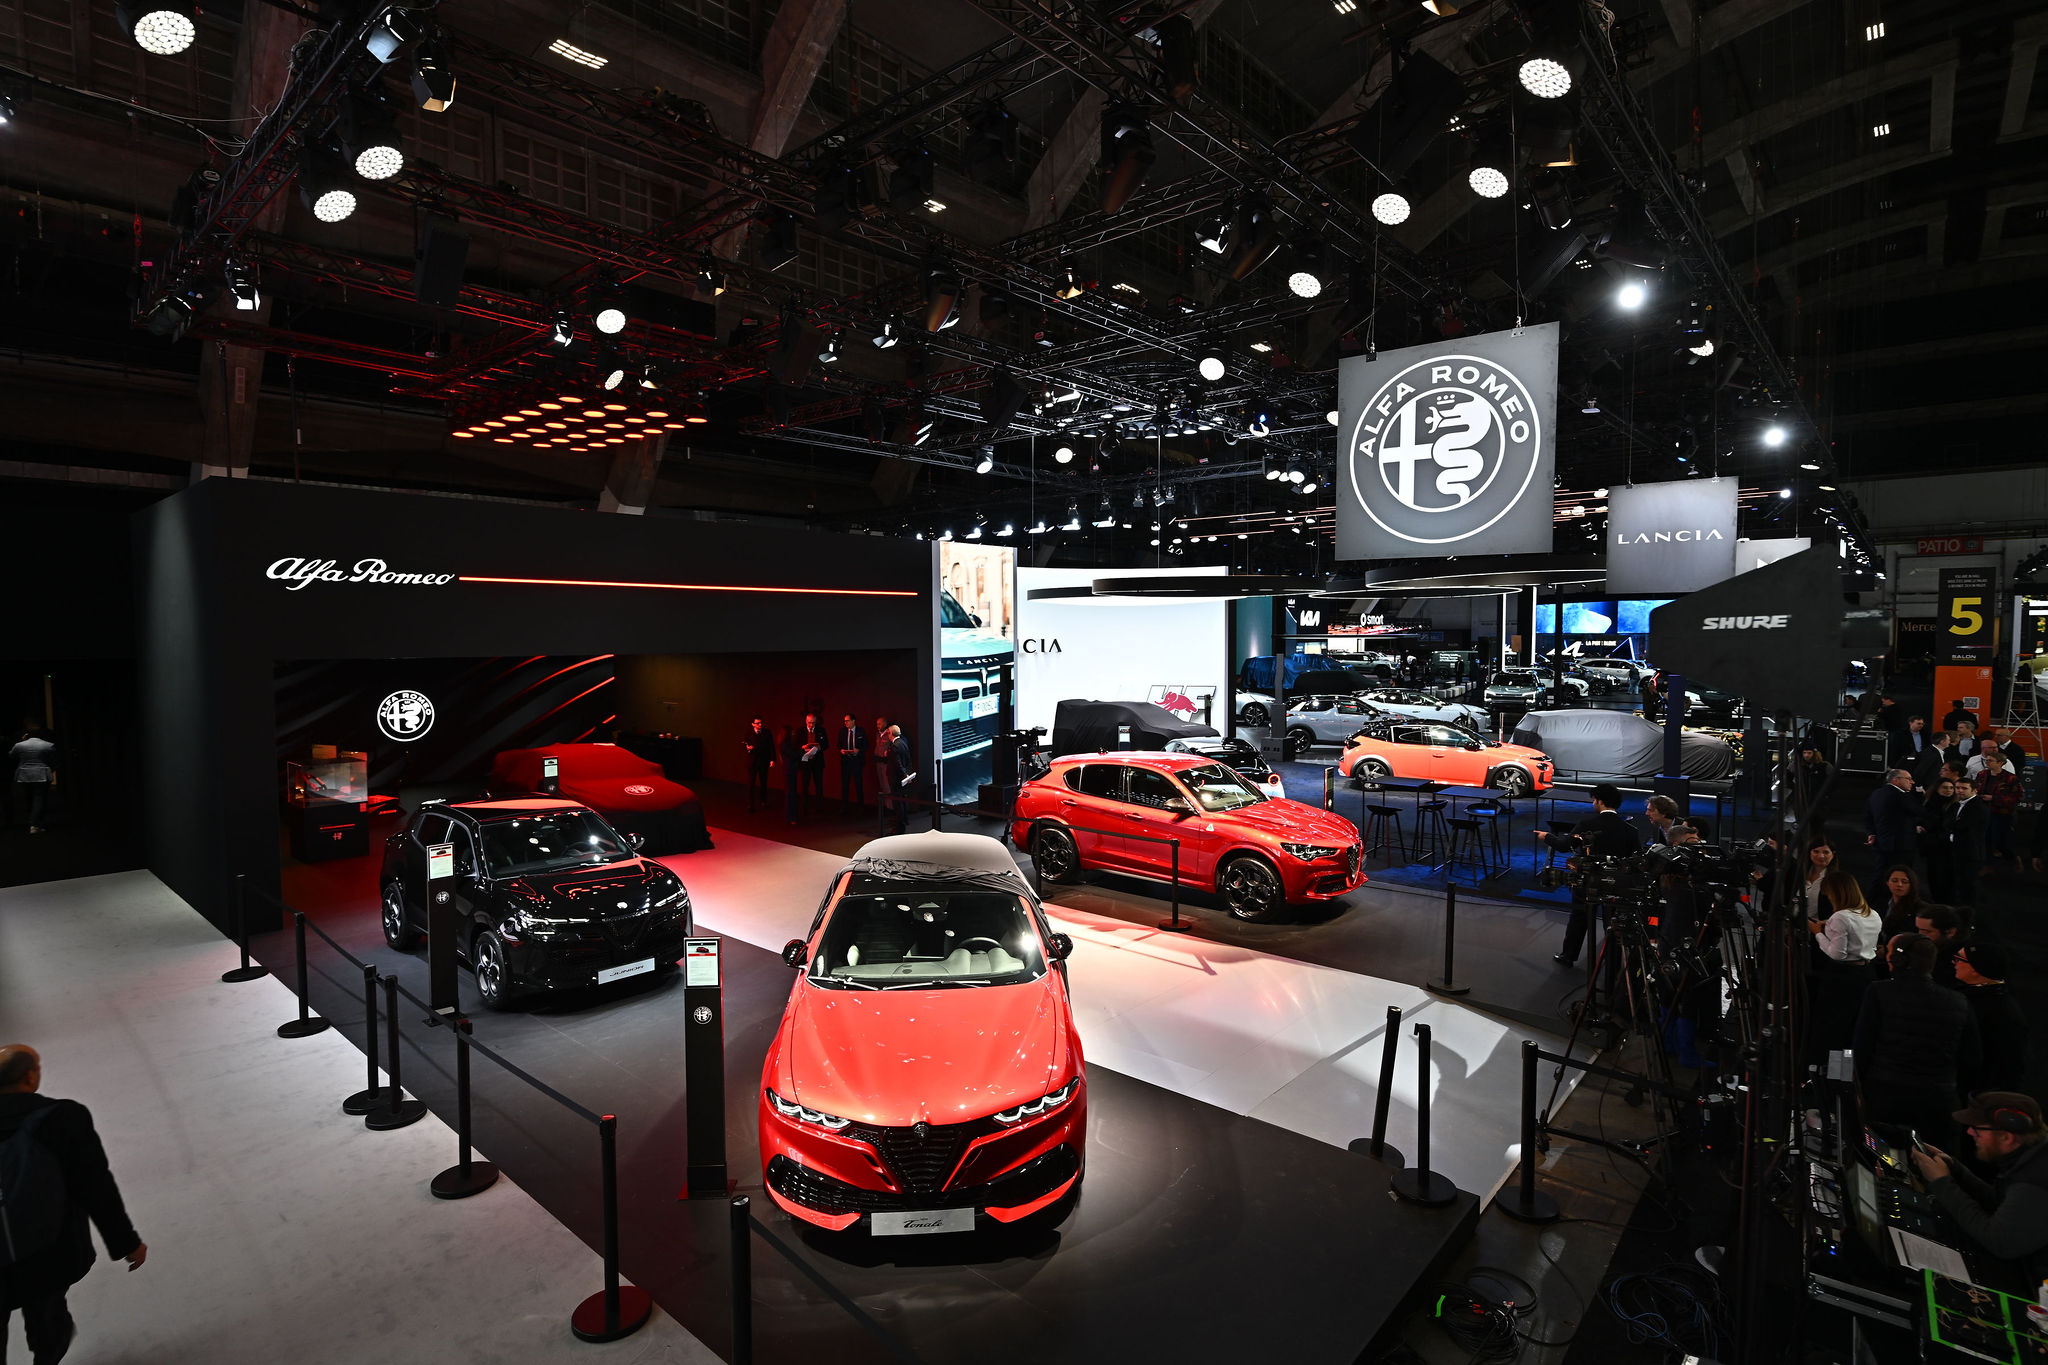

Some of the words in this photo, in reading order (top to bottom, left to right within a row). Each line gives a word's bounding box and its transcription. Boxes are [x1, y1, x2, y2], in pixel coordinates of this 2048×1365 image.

[1358, 381, 1417, 459] ALFA
[1430, 365, 1530, 445] ROMEO
[1618, 528, 1724, 545] LANCIA
[1917, 539, 1961, 553] PATIO
[265, 557, 348, 591] Alfa
[348, 558, 456, 586] Romeo
[1366, 614, 1384, 626] smart
[1702, 614, 1789, 630] SHURE
[1948, 597, 1983, 636] 5
[1017, 638, 1062, 654] CIA
[958, 657, 999, 665] LANCIA
[380, 696, 399, 718] ALFA
[402, 692, 432, 716] ROMEO
[609, 965, 644, 977] JUNIOR
[903, 1219, 945, 1229] Tonale
